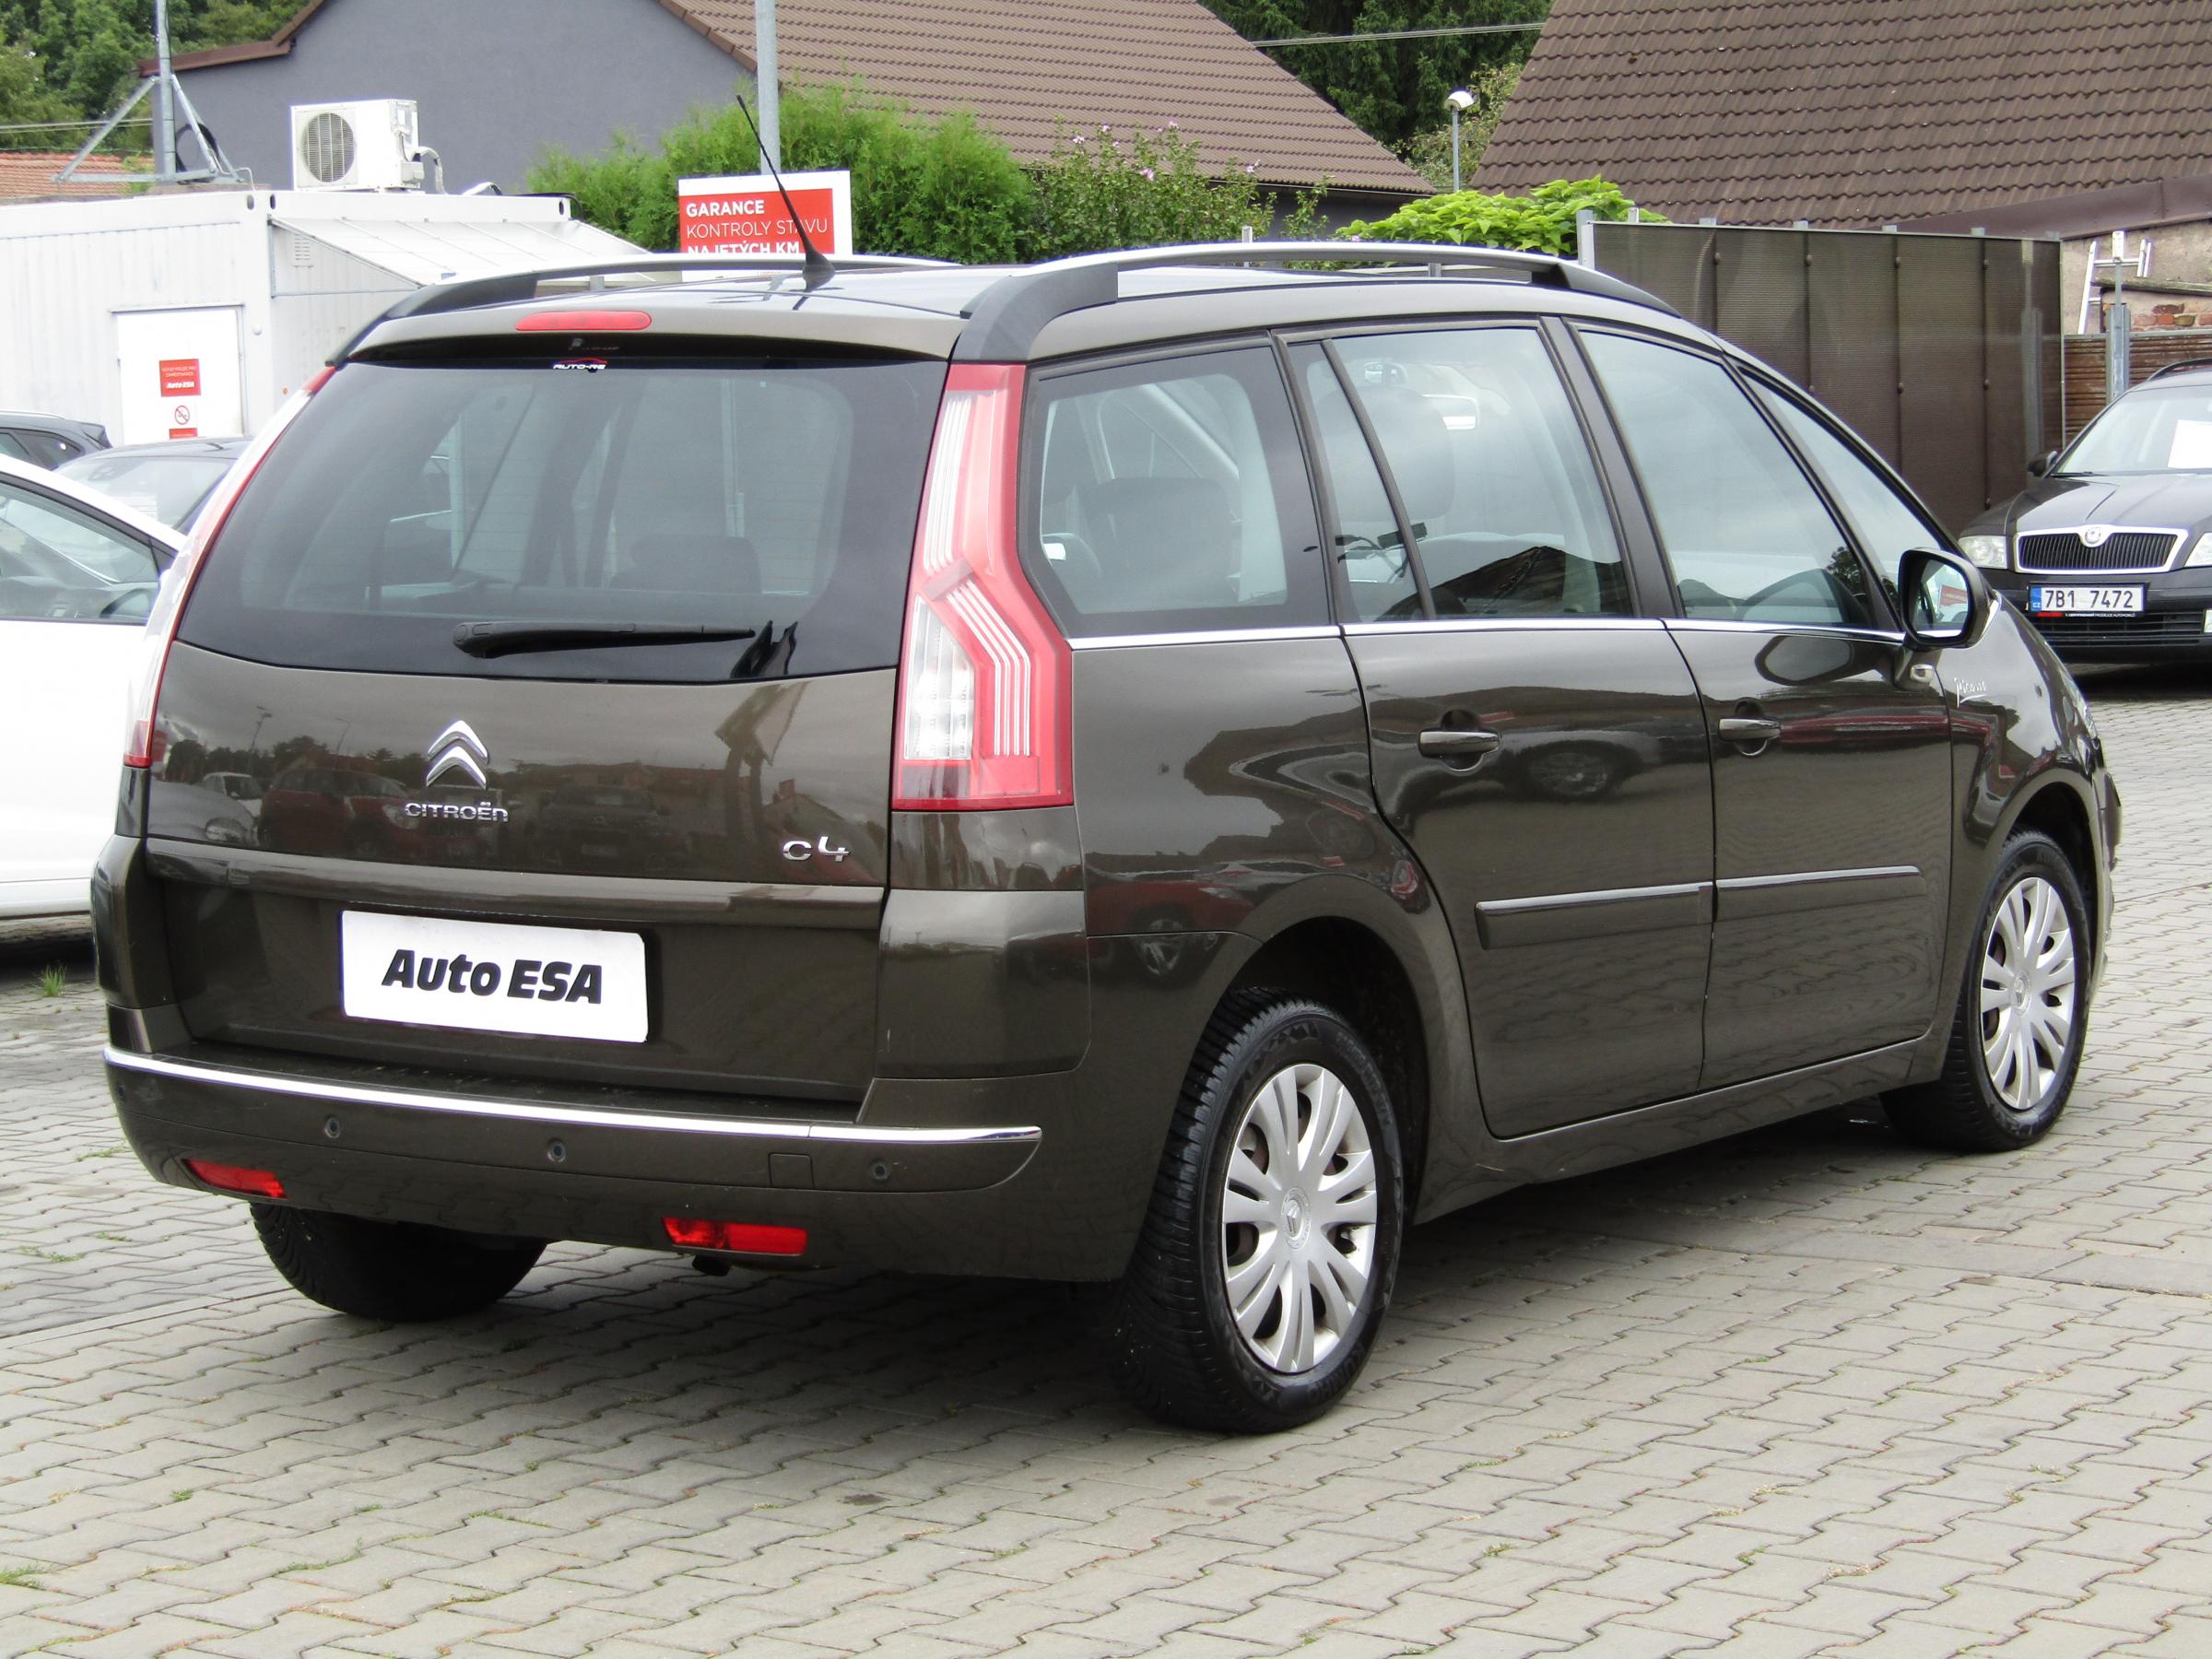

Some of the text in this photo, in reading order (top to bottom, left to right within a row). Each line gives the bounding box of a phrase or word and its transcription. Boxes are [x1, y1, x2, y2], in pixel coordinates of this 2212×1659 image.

[686, 199, 765, 218] GARANCE
[686, 221, 771, 239] KONTROLY
[775, 241, 800, 253] KM
[2044, 590, 2076, 608] 7B1
[2089, 590, 2134, 608] 7472
[404, 801, 509, 822] CITROËN
[782, 835, 851, 862] C4
[381, 948, 603, 1005] Auto ESA
